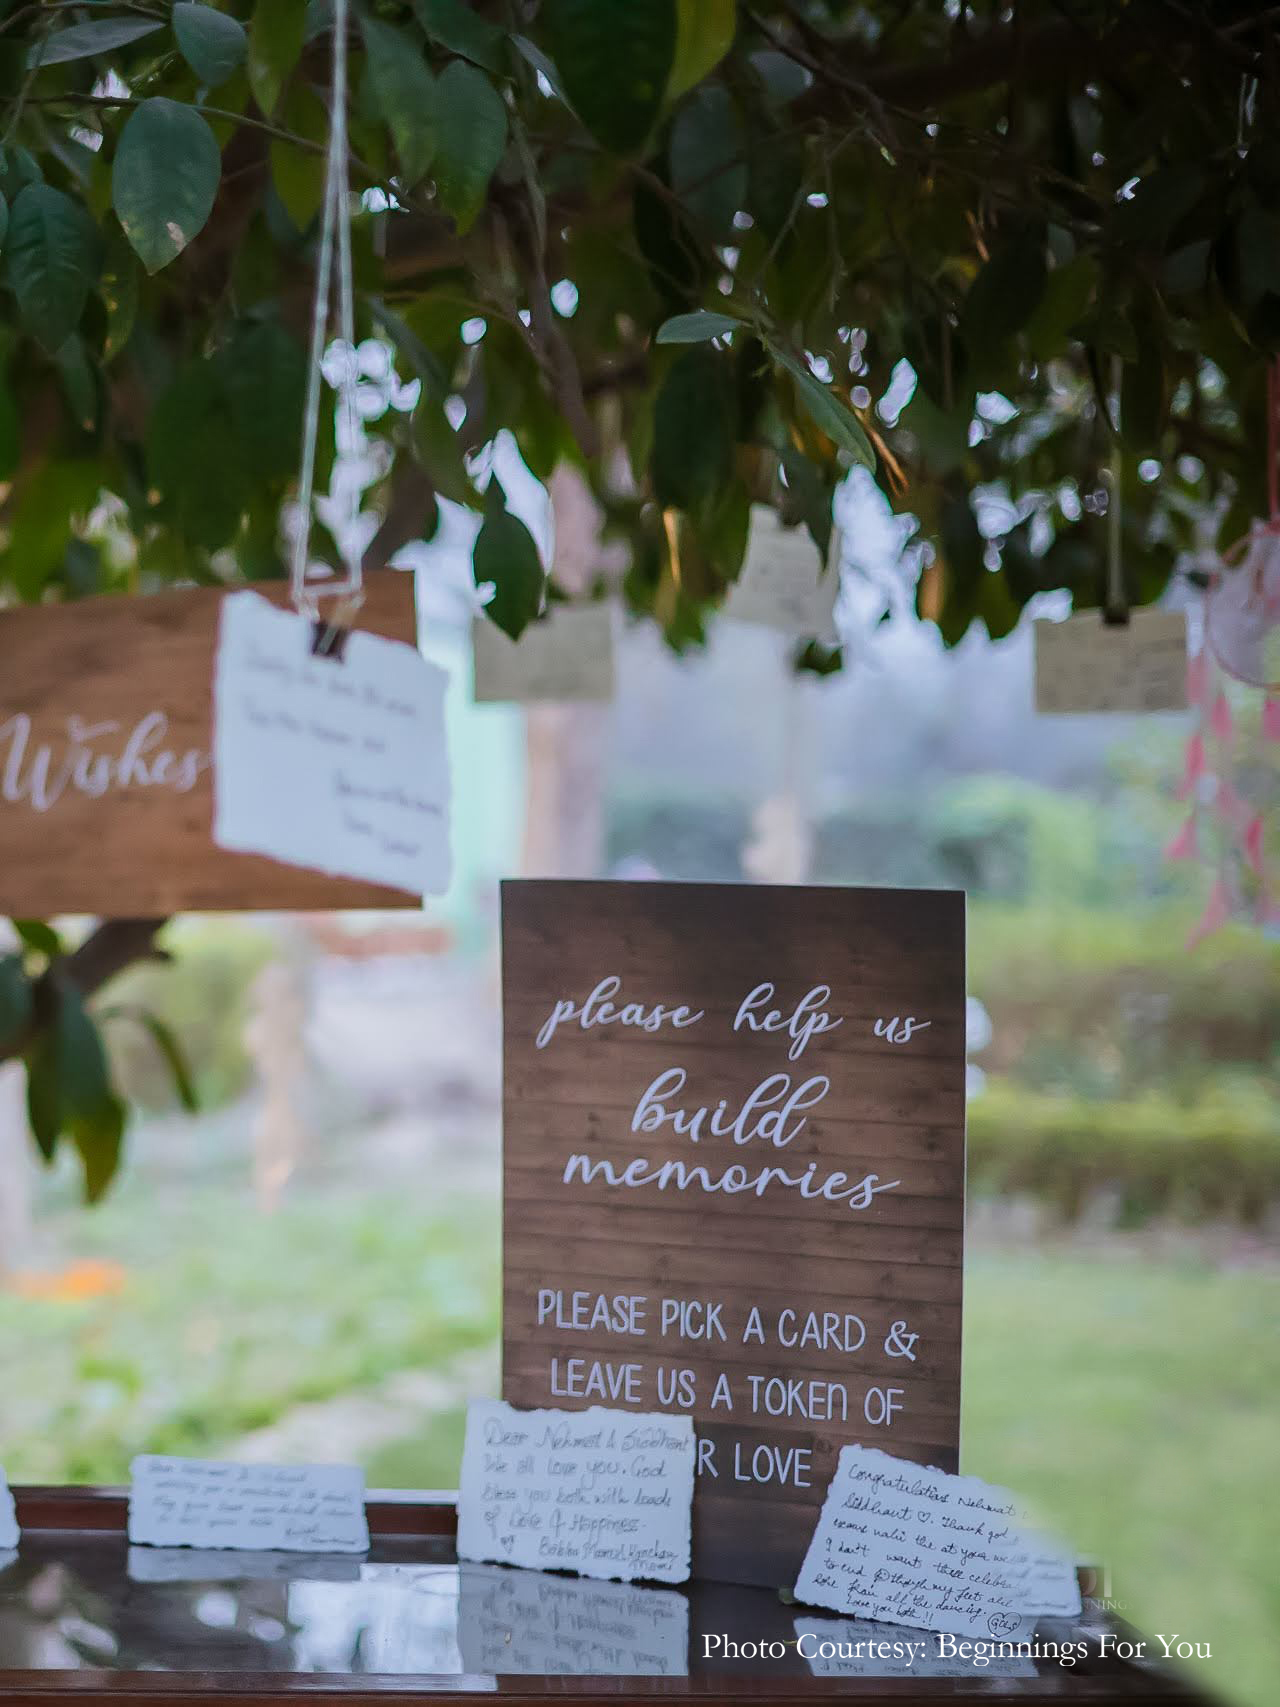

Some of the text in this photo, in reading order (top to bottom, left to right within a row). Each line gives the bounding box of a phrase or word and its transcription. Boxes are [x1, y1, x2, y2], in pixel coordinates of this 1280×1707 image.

[535, 975, 932, 1061] please help us
[630, 1067, 830, 1149] build
[562, 1152, 901, 1211] memories
[538, 1289, 919, 1362] PLEASE PICK A CARD &
[550, 1358, 642, 1403] LEAVE
[657, 1367, 697, 1408] US
[711, 1373, 734, 1412] A
[864, 1386, 906, 1426] OF
[484, 1417, 528, 1446] Dear
[631, 1455, 666, 1478] God
[734, 1443, 813, 1489] LOVE
